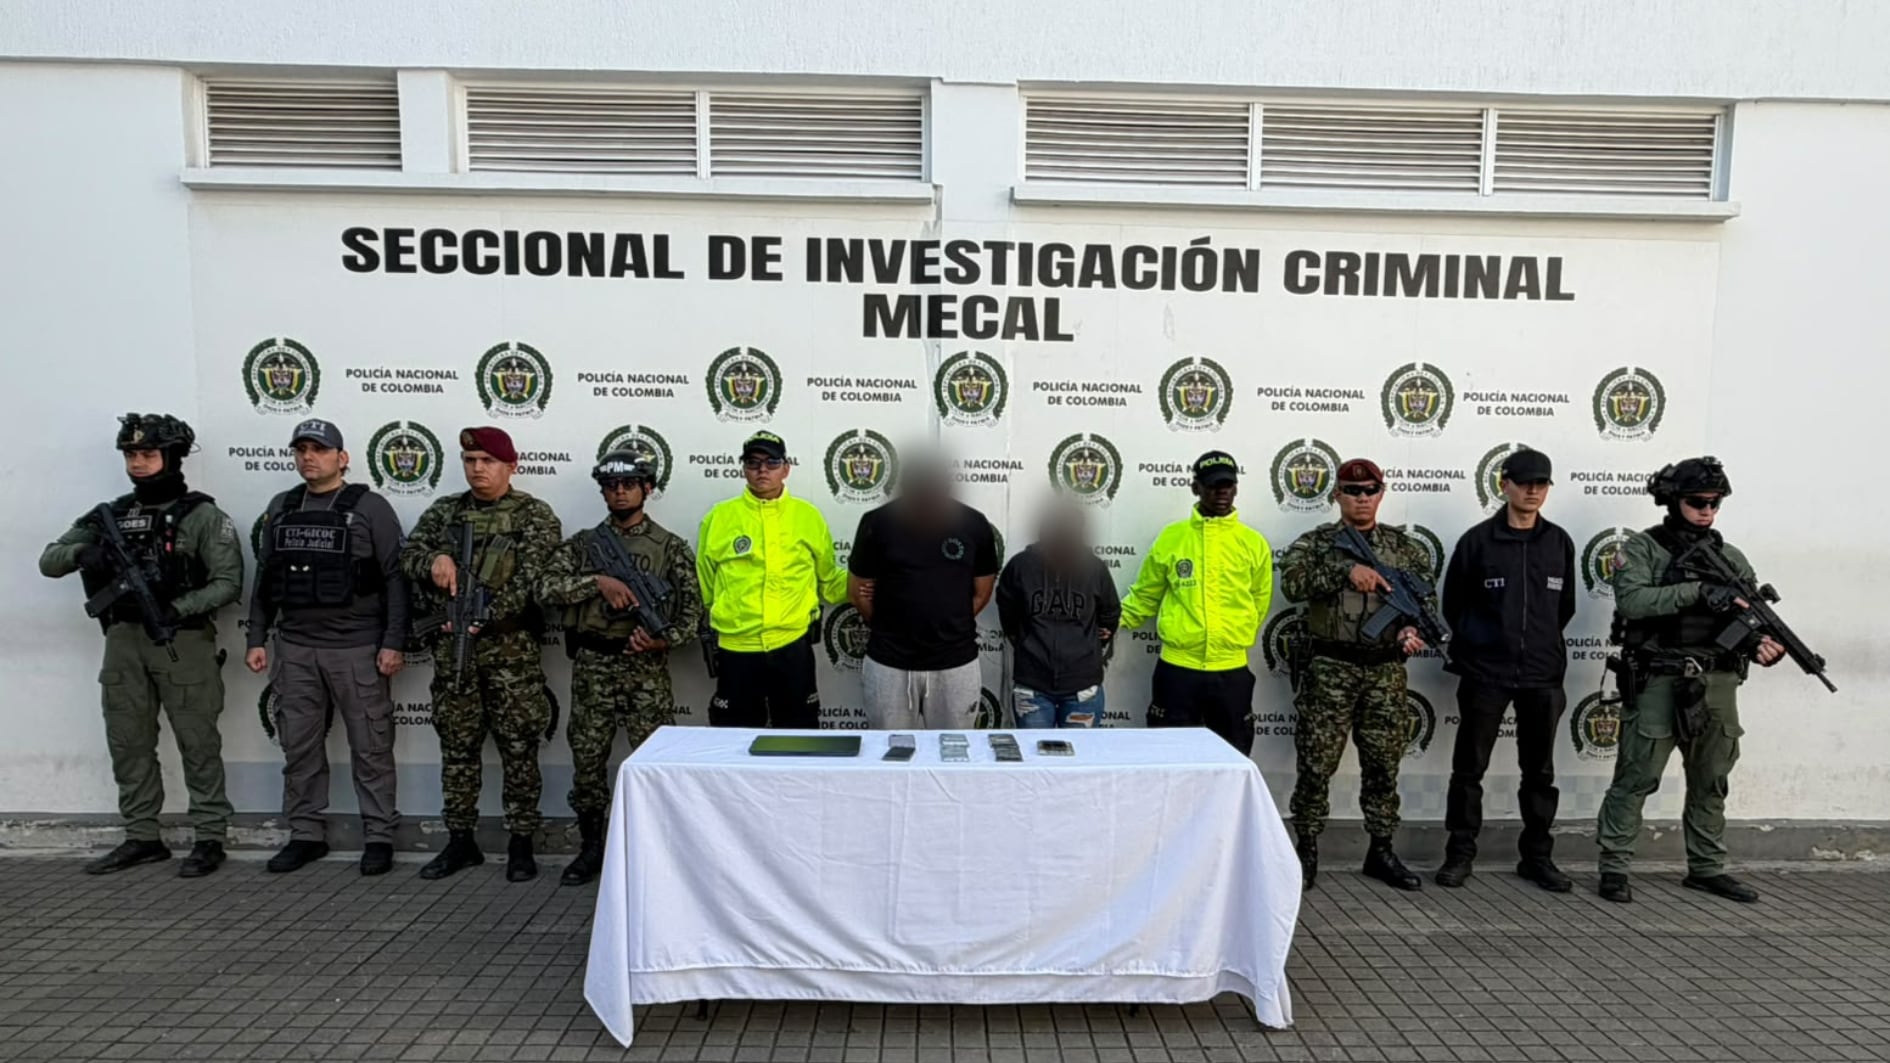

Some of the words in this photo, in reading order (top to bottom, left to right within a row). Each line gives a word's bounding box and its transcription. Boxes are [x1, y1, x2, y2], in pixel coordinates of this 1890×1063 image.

[342, 227, 685, 280] SECCIONAL
[708, 235, 783, 281] DE
[806, 236, 1260, 293] INVESTIGACIÓN
[1284, 249, 1575, 300] CRIMINAL
[863, 293, 1074, 342] MECAL
[346, 366, 392, 379] POLICÍA
[396, 369, 459, 380] NACIONAL
[578, 370, 624, 383] POLICÍA
[627, 373, 690, 384] NACIONAL
[807, 374, 853, 388] POLICÍA
[855, 378, 917, 389] NACIONAL
[1033, 380, 1078, 392] POLICÍA
[1081, 382, 1143, 393] NACIONAL
[362, 383, 376, 392] DE
[380, 383, 444, 393] COLOMBIA
[593, 387, 608, 396] DE
[612, 387, 674, 398] COLOMBIA
[1257, 385, 1302, 397] POLICÍA
[1305, 388, 1365, 399] NACIONAL
[822, 391, 837, 401] DE
[840, 391, 902, 402] COLOMBIA
[1048, 396, 1062, 405] DE
[1065, 396, 1127, 406] COLOMBIA
[1463, 389, 1507, 402] POLICÍA
[1511, 393, 1570, 404] NACIONAL
[1271, 401, 1286, 411] DE
[1289, 401, 1349, 412] COLOMBIA
[1477, 406, 1492, 415] DE
[1495, 406, 1554, 416] COLOMBIA
[229, 446, 275, 457] POLICÍA
[519, 452, 572, 462] ACIONAL
[689, 453, 735, 465] POLICÍA
[245, 461, 260, 471] DE
[264, 461, 295, 471] COLO
[606, 461, 624, 473] PM
[964, 460, 1024, 470] NACIONAL
[1138, 462, 1183, 473] POLICÍA
[517, 466, 557, 475] OMBIA
[704, 469, 720, 478] DE
[1407, 469, 1466, 479] NACIONAL
[955, 473, 1008, 483] OLOMBIA
[1570, 469, 1614, 481] POLICÍA
[1617, 473, 1649, 483] NACIO
[1153, 477, 1167, 486] DE
[1391, 482, 1451, 492] COLOMBIA
[1584, 486, 1598, 495] DE
[1601, 486, 1648, 496] COLOMB
[1094, 546, 1136, 556] CIONAL
[1484, 578, 1504, 588] CTI
[1031, 590, 1086, 617] GAP
[1566, 636, 1602, 647] OLICÍA
[1572, 651, 1586, 660] DE
[823, 721, 835, 729] DE
[1256, 727, 1270, 735] DE
